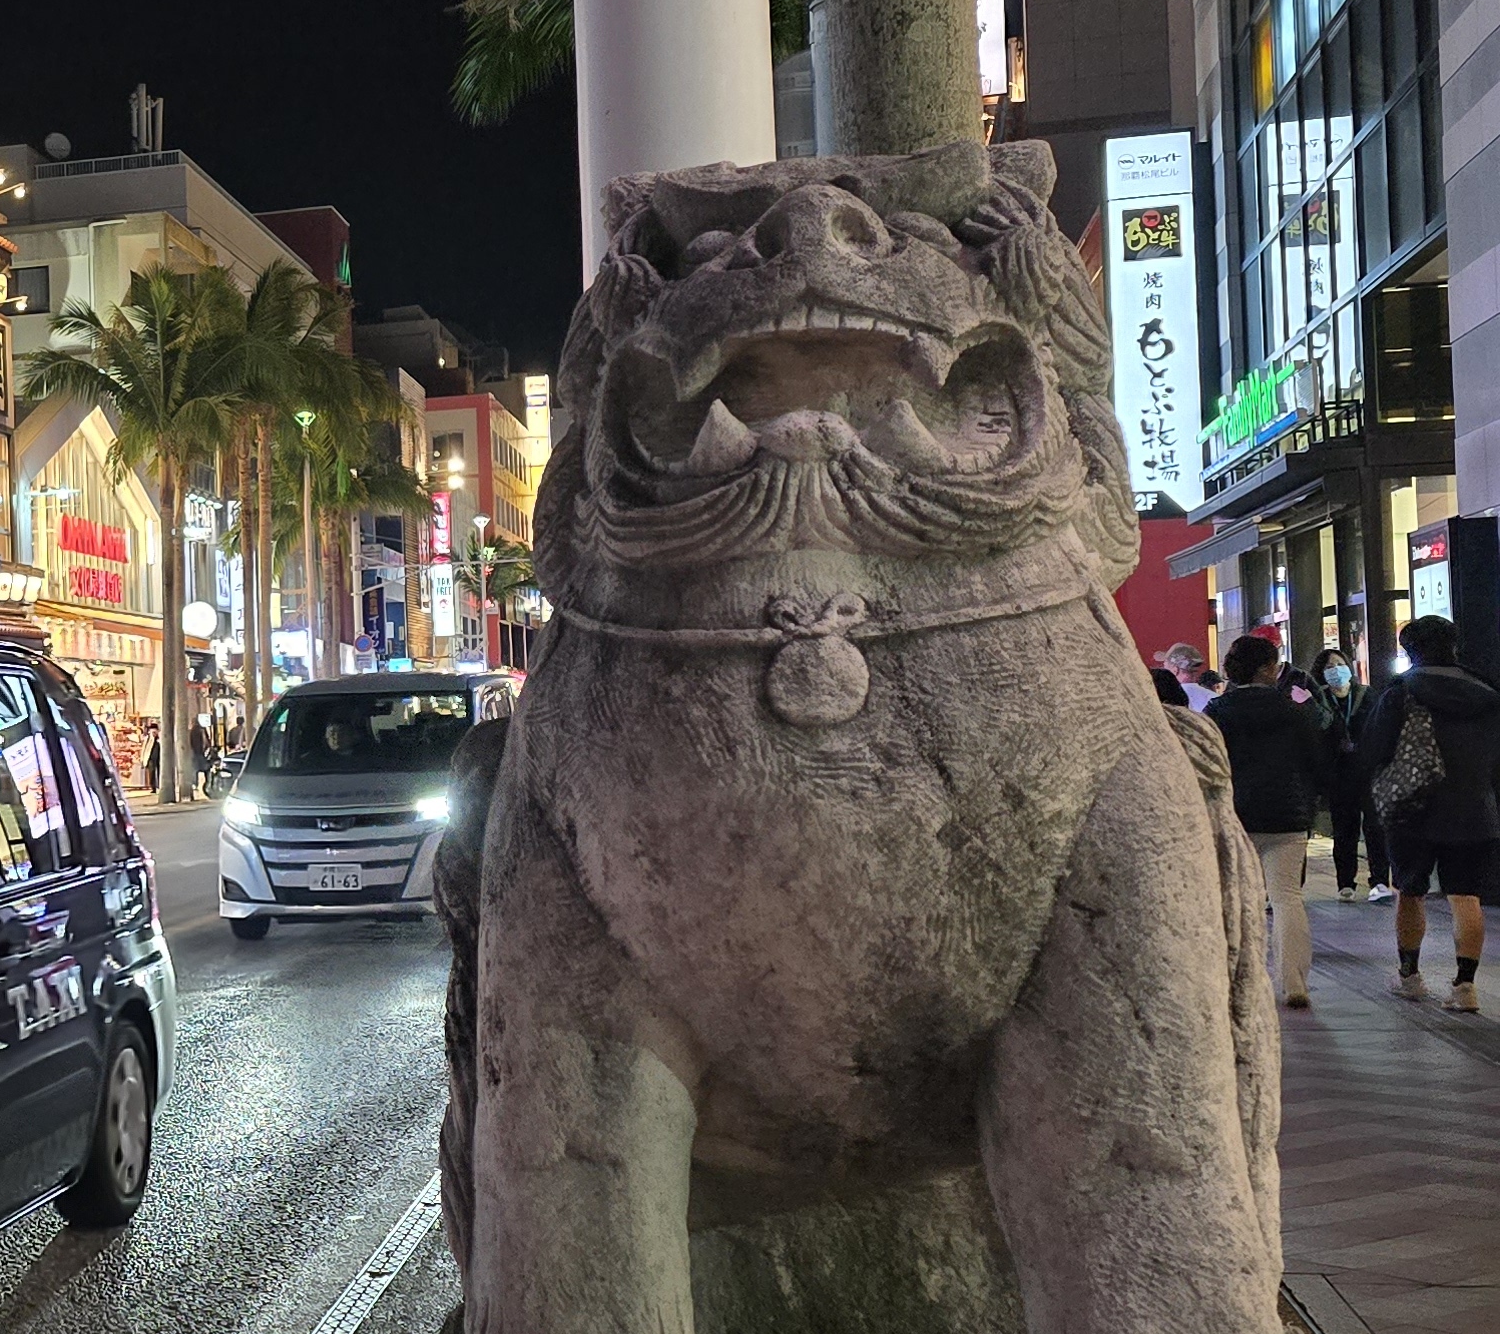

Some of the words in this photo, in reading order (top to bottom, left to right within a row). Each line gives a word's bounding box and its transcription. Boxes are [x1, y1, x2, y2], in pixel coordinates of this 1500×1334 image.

[1137, 153, 1182, 164] マルイト
[1121, 167, 1179, 180] 那覇松尾ビル
[1143, 271, 1163, 309] 焼肉
[1136, 318, 1180, 482] もとぶ牧場
[1134, 493, 1158, 512] 2F
[320, 875, 359, 888] 61-63
[7, 966, 87, 1040] TAXI
